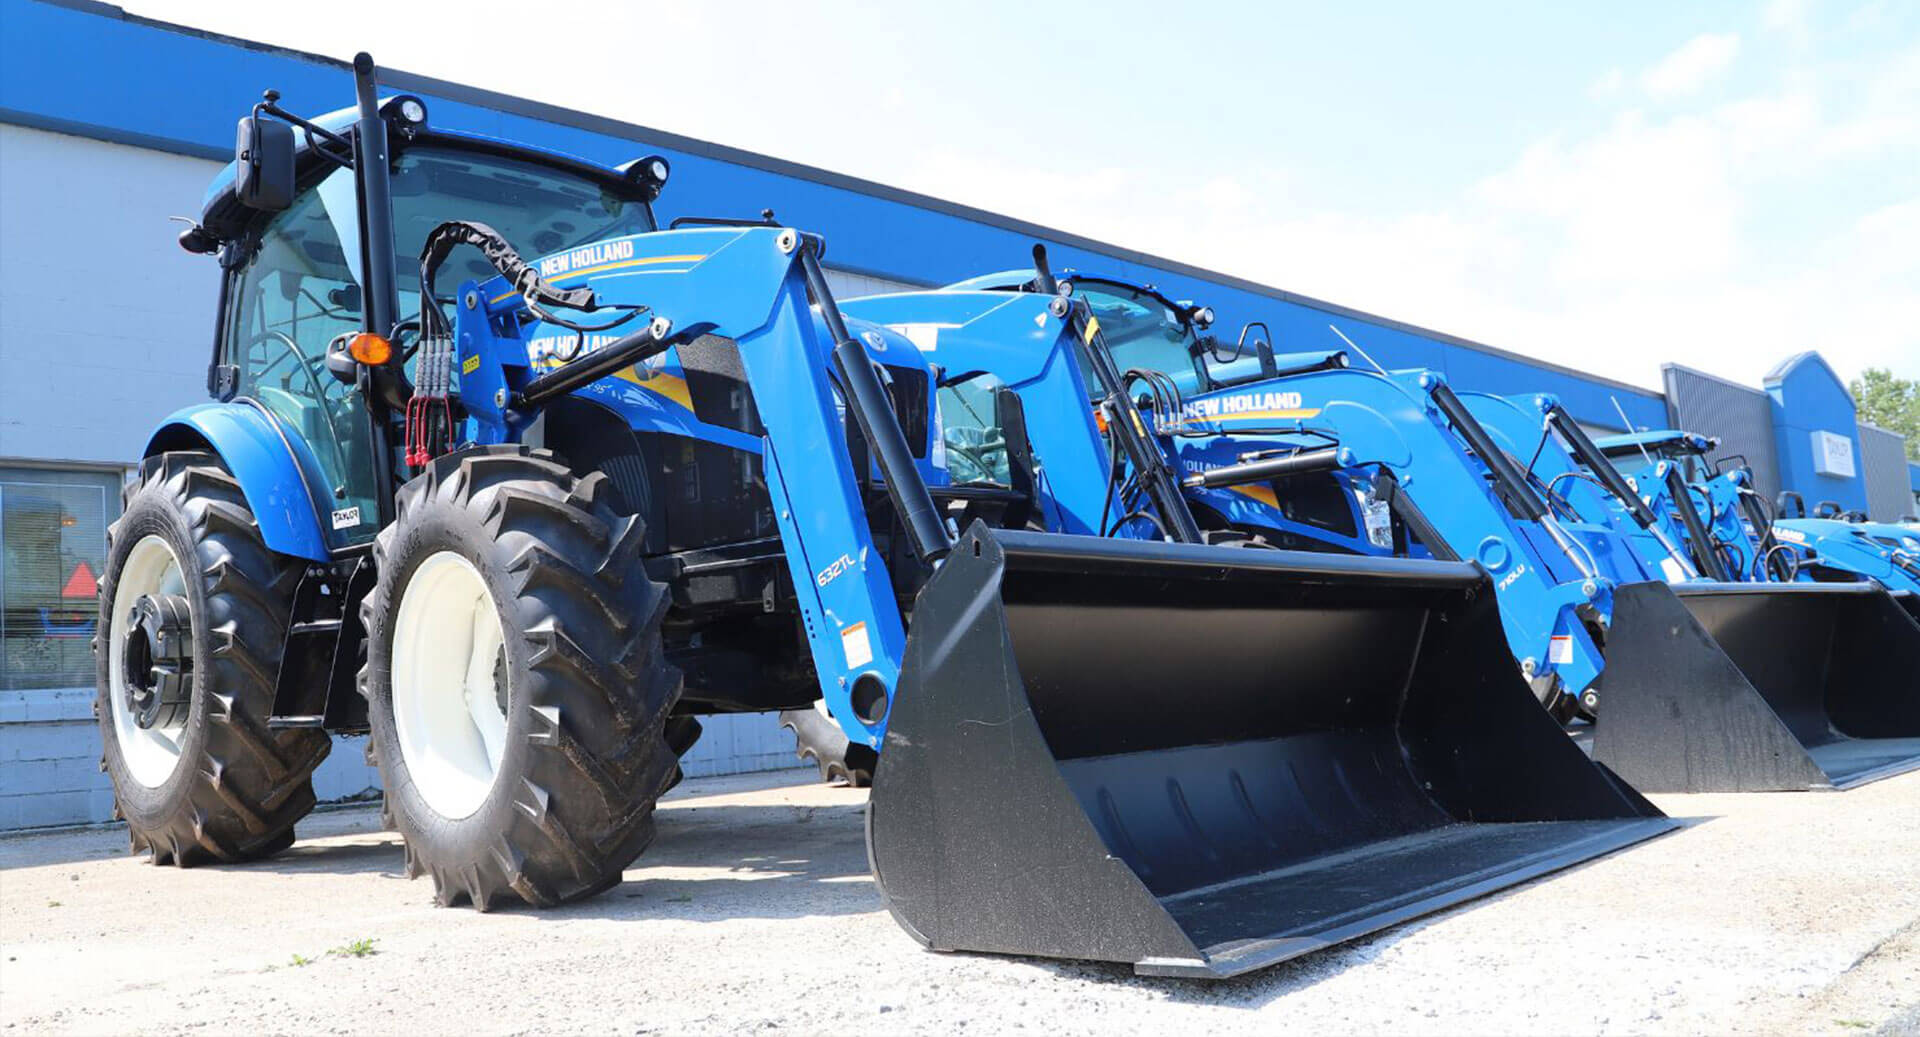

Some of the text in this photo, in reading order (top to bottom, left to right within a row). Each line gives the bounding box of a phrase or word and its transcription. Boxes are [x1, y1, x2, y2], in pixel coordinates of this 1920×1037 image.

[541, 241, 634, 277] NEW HOLLAND
[526, 337, 555, 359] NEW
[1182, 392, 1302, 417] NEW HOLLAND
[817, 553, 856, 587] 632TL
